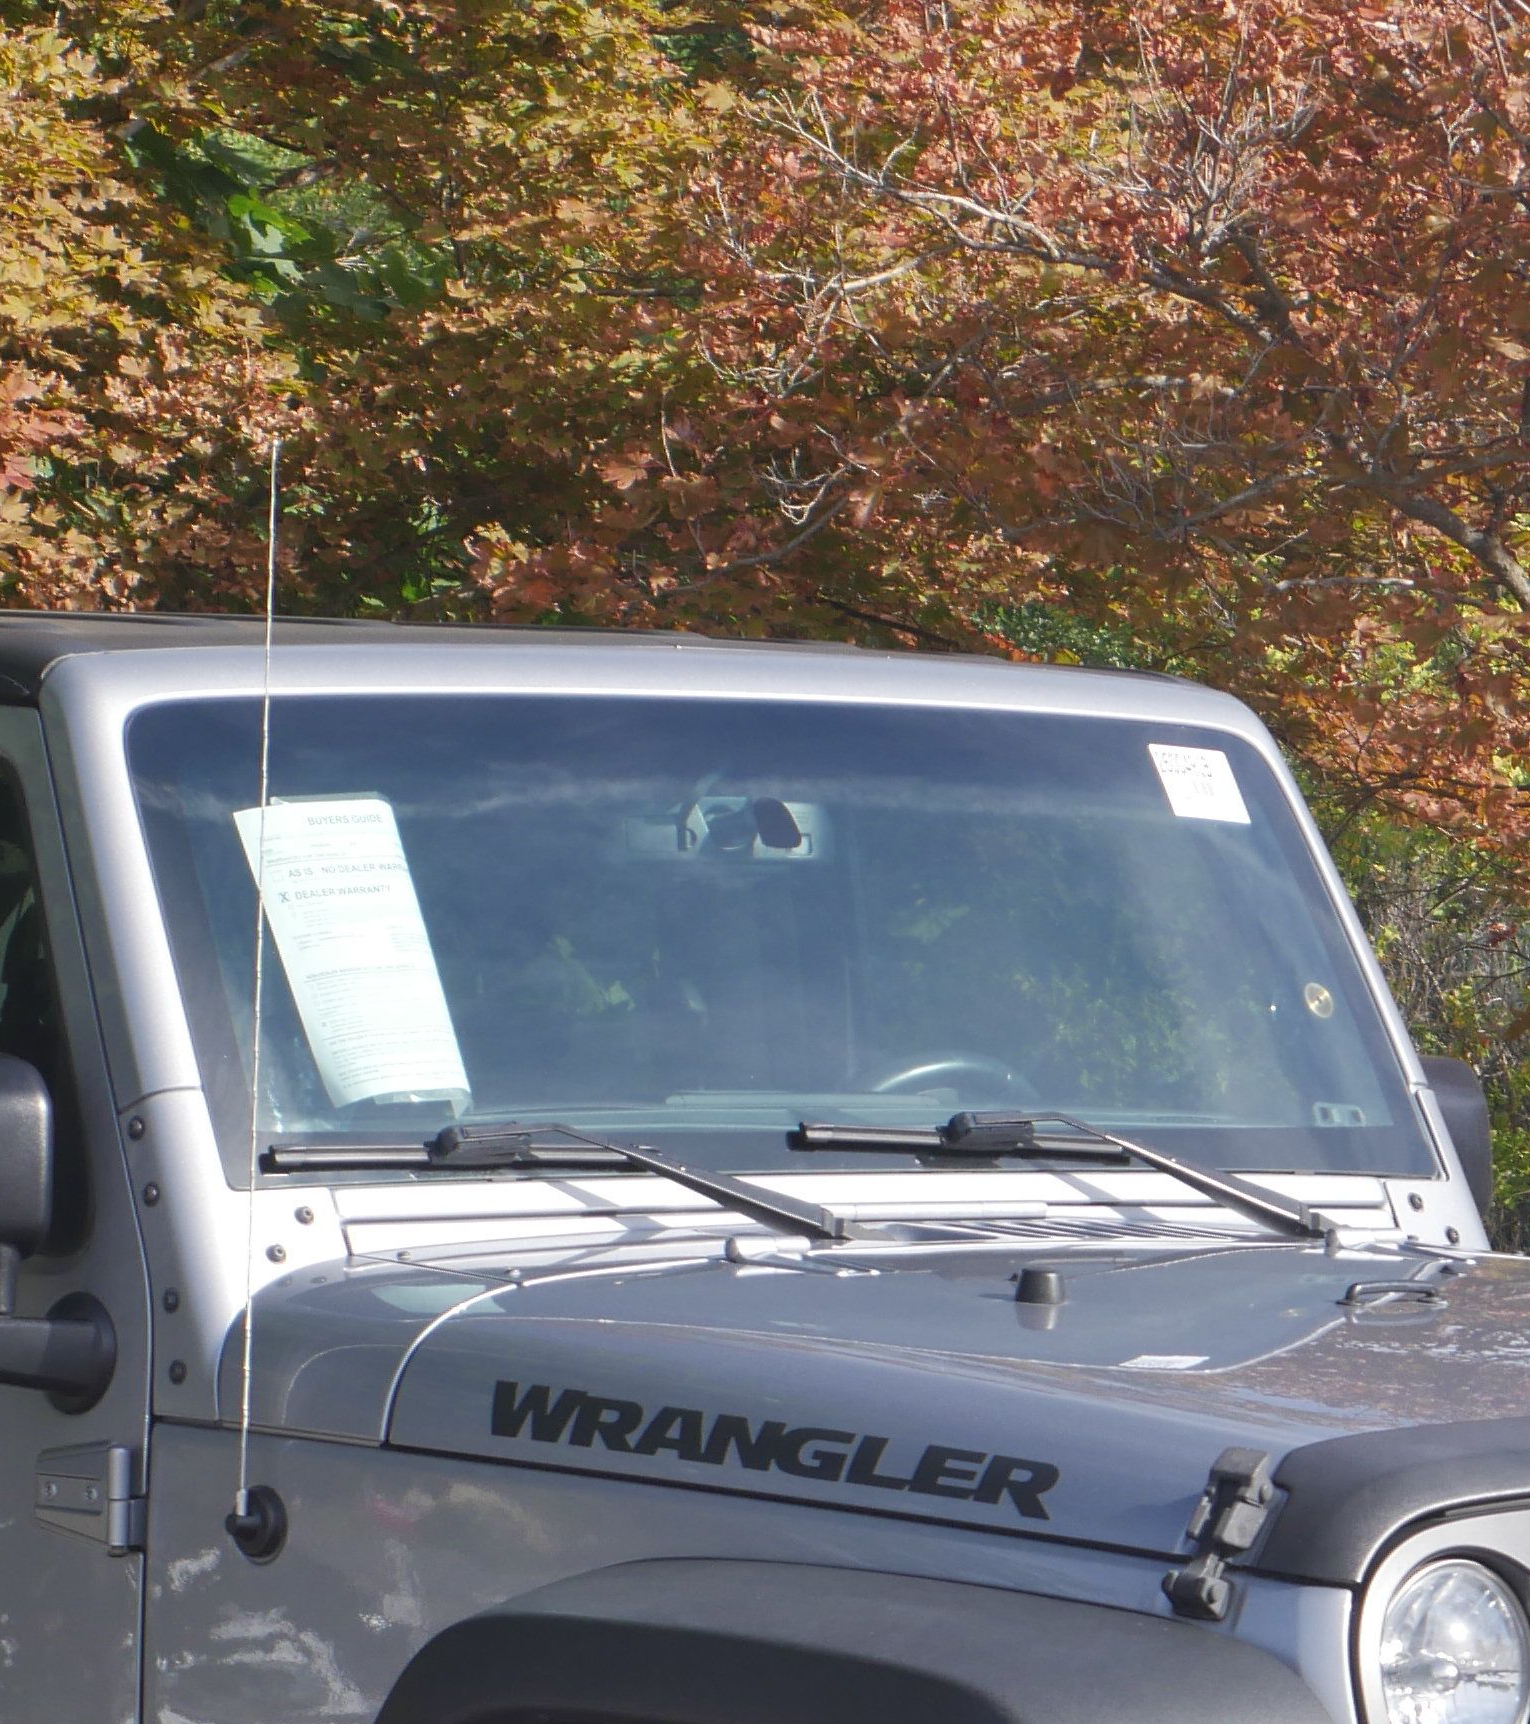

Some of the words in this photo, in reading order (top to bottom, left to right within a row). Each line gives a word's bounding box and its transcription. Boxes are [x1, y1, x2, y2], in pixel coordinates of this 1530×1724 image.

[307, 815, 350, 826] BUYERS
[351, 813, 384, 824] GUIDE
[288, 868, 302, 878] AS
[304, 867, 314, 876] IS
[338, 863, 376, 874] DEALER
[295, 888, 336, 901] DEALER
[337, 884, 391, 896] WARRANTY
[490, 1380, 1060, 1520] WRANGLER
